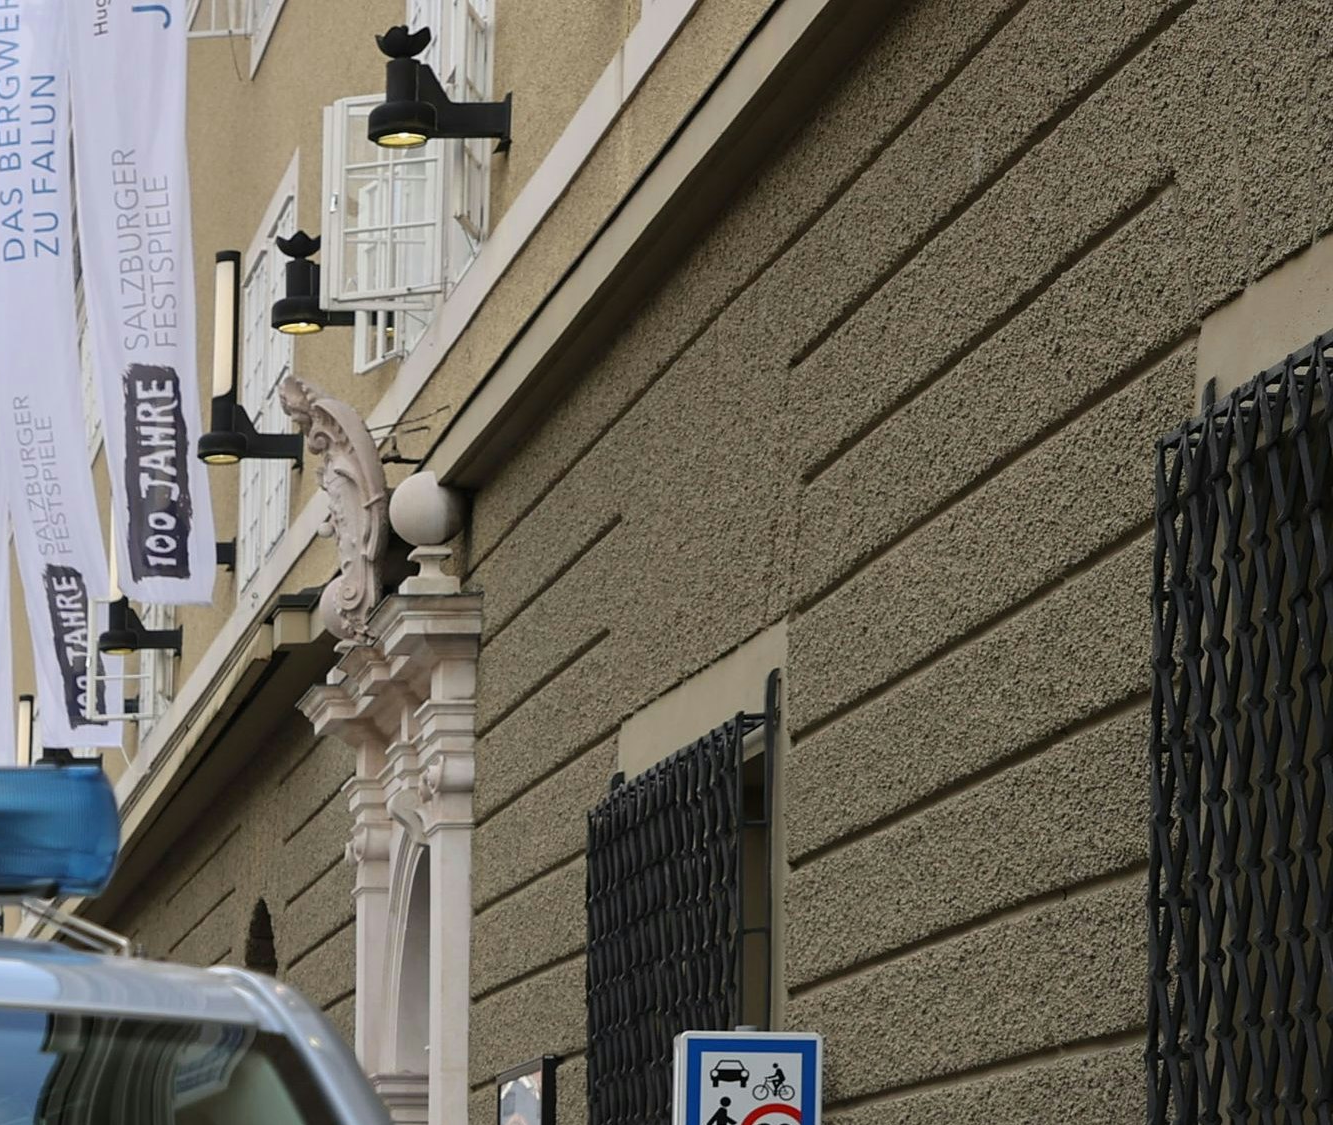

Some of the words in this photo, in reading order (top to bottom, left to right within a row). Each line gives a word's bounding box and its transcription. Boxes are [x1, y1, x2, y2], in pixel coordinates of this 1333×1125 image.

[131, 4, 172, 30] J
[30, 75, 57, 194] FALUN
[0, 187, 26, 262] DAS
[33, 212, 59, 257] ZU
[112, 149, 150, 350] SALZBURGER
[143, 175, 177, 348] FESTSPIELE
[13, 395, 55, 556] SALZBURGER
[36, 416, 73, 554] FESTSPIELE
[135, 379, 180, 501] JAHRE
[145, 511, 177, 567] 100
